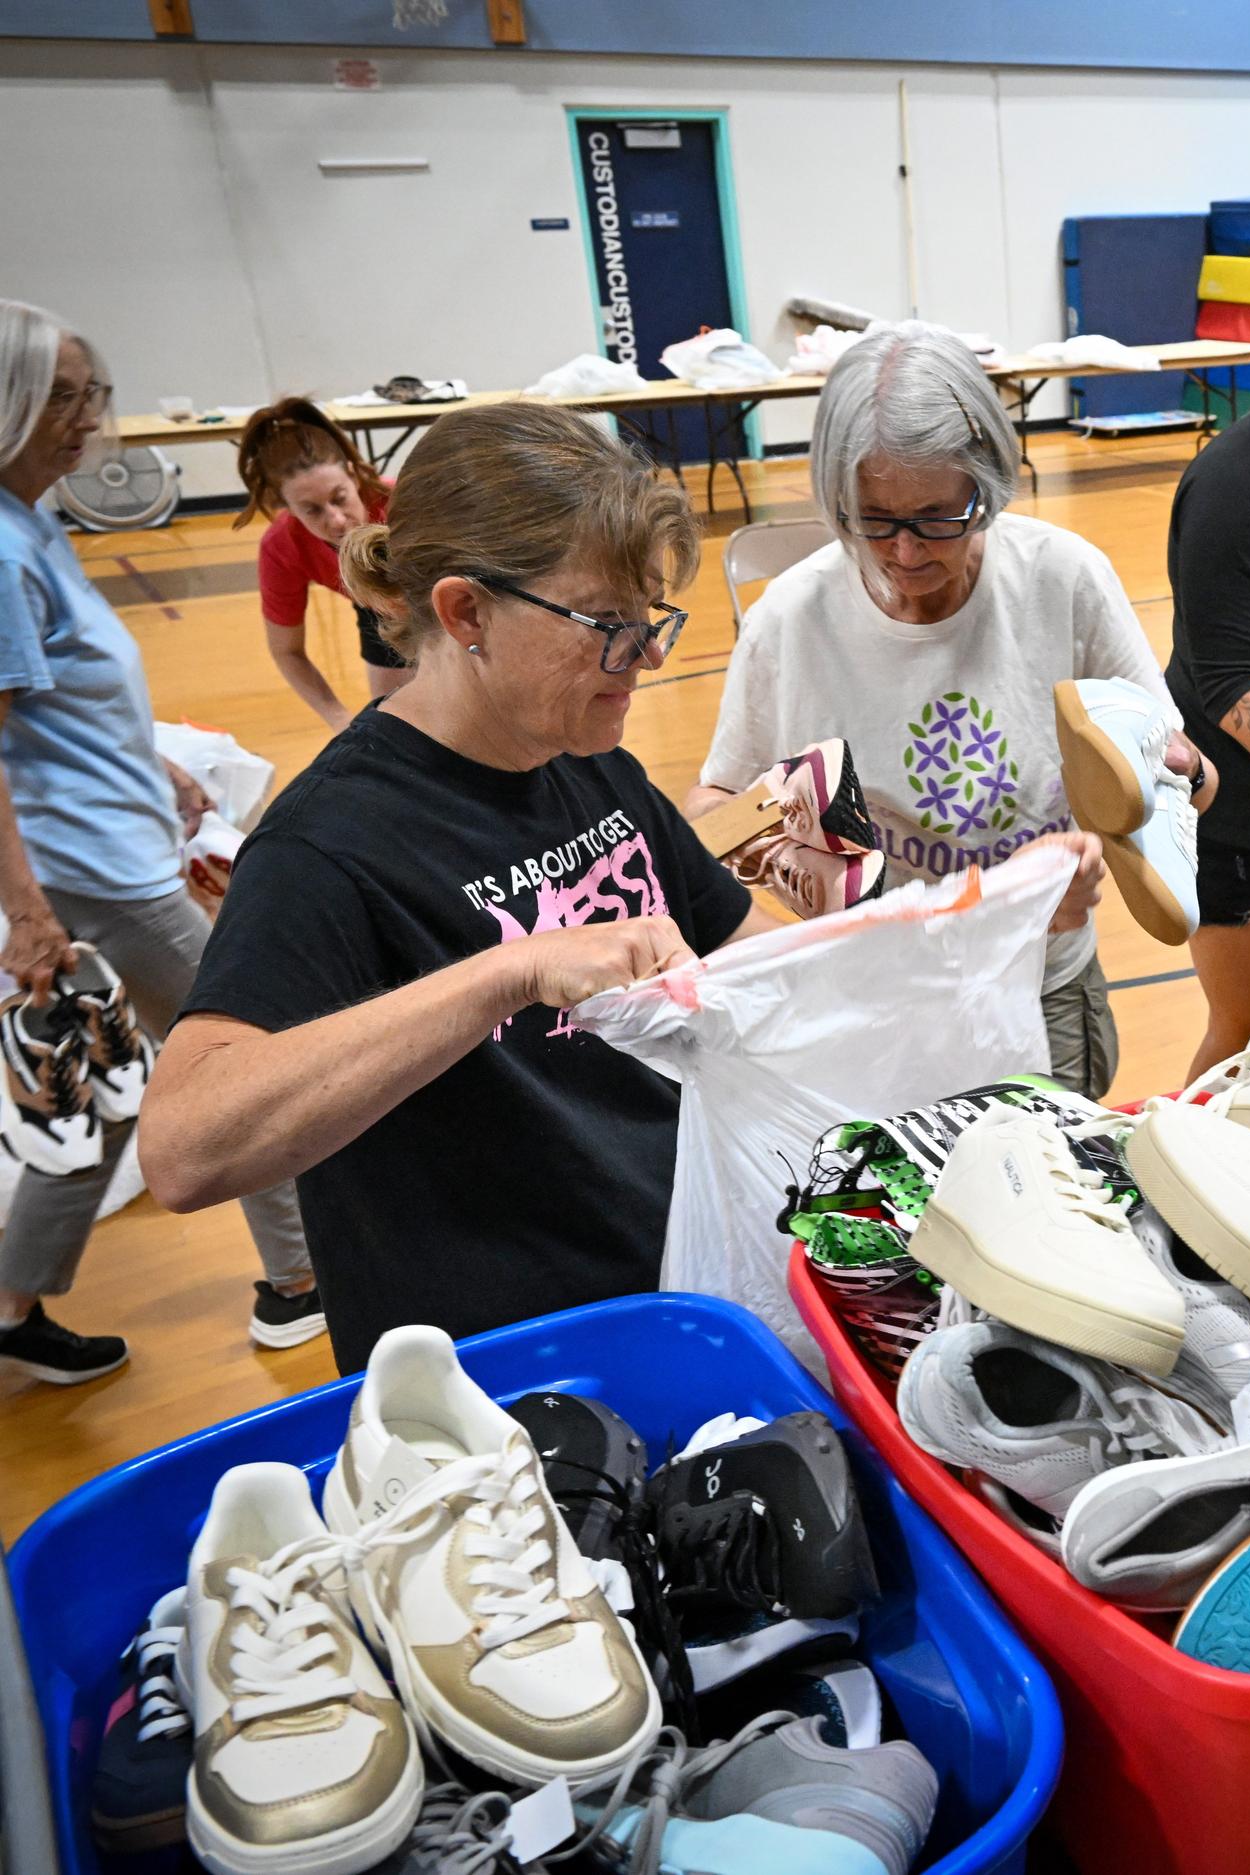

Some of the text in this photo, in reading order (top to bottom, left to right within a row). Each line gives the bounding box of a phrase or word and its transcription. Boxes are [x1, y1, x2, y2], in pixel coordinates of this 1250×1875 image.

[462, 810, 635, 910] IT'S ABOUT TO GET
